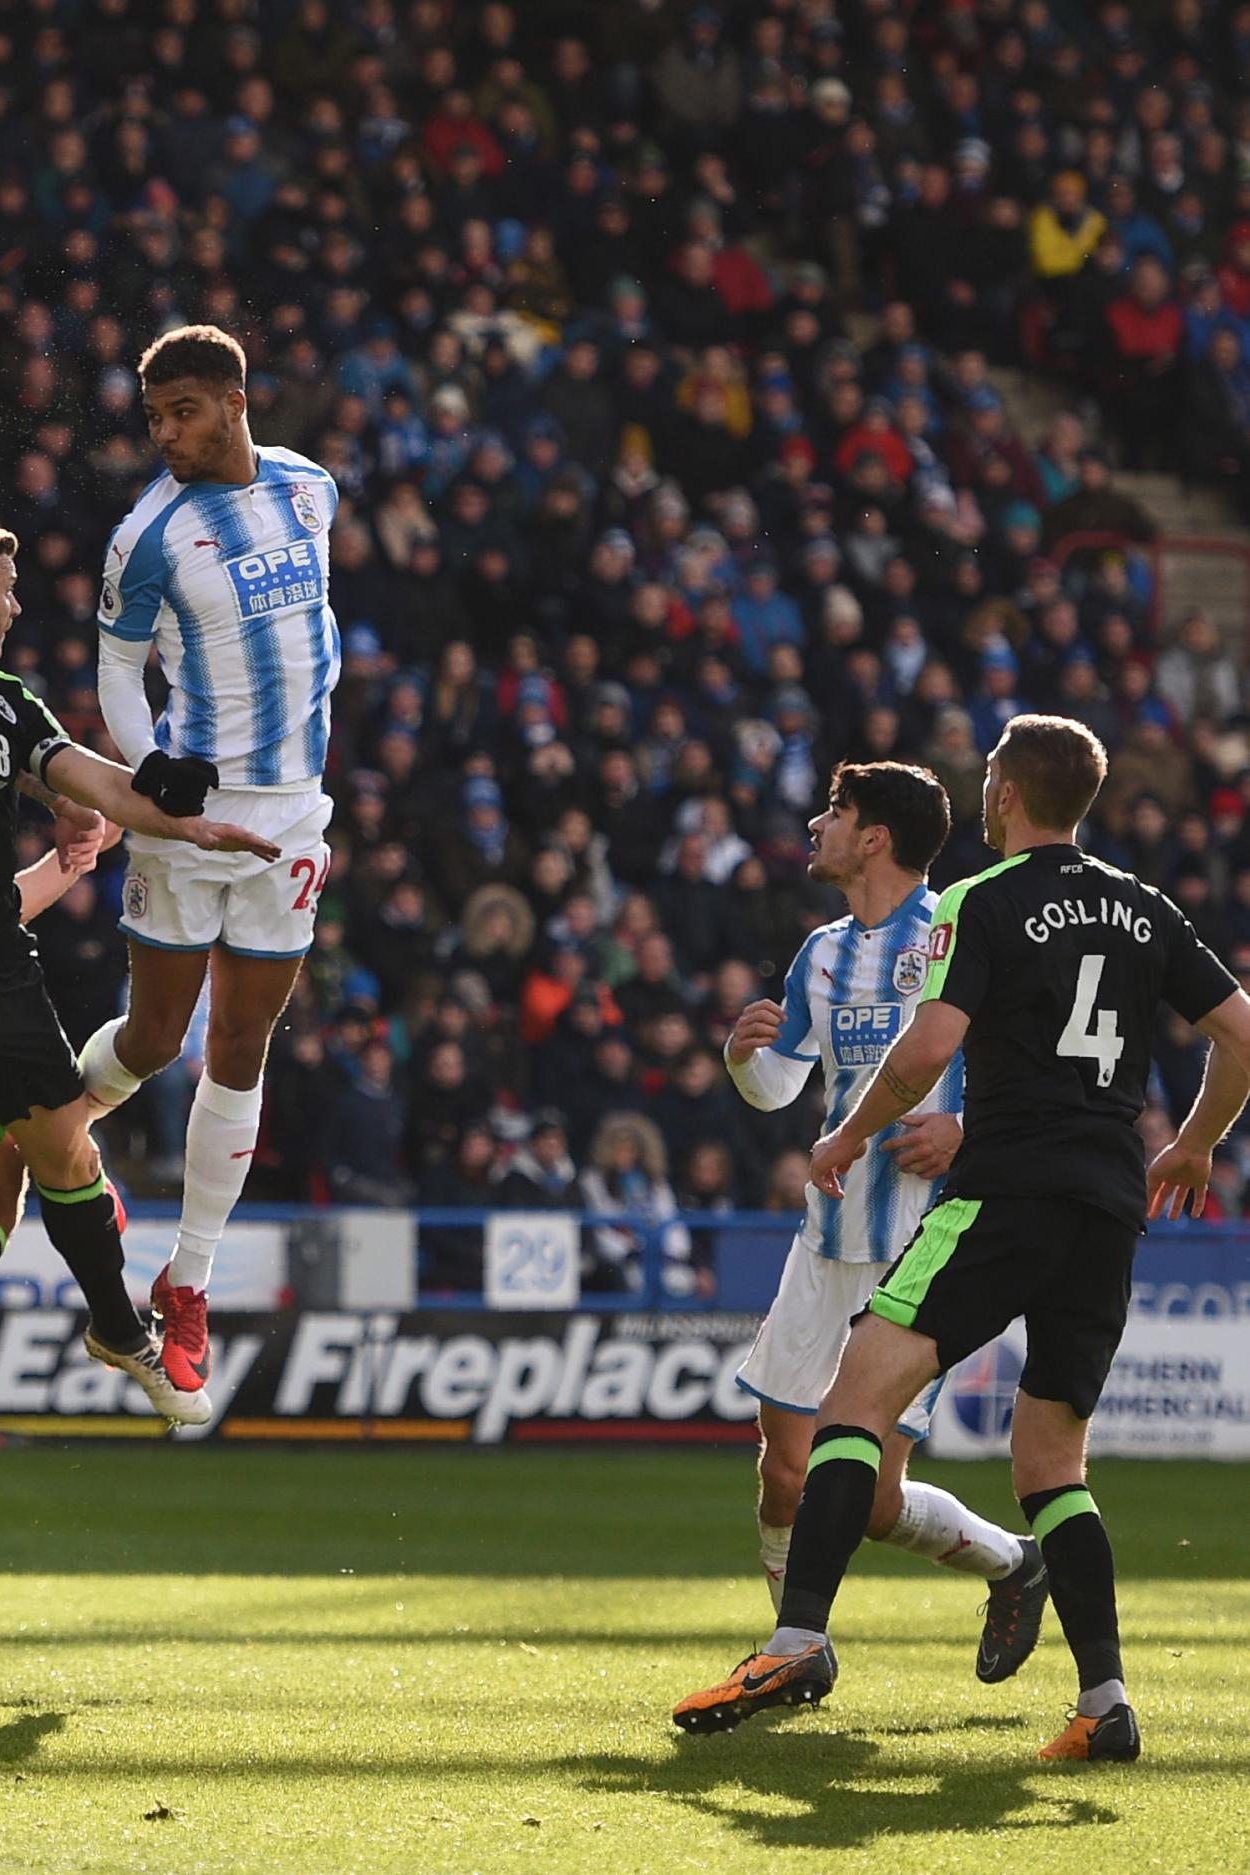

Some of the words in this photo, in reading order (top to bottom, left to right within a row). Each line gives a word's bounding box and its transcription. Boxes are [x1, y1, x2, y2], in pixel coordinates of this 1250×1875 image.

[238, 544, 312, 580] OPE
[1024, 897, 1152, 944] GOSLING
[836, 1007, 892, 1031] OPE
[1056, 954, 1125, 1088] 4
[498, 1228, 568, 1293] 29
